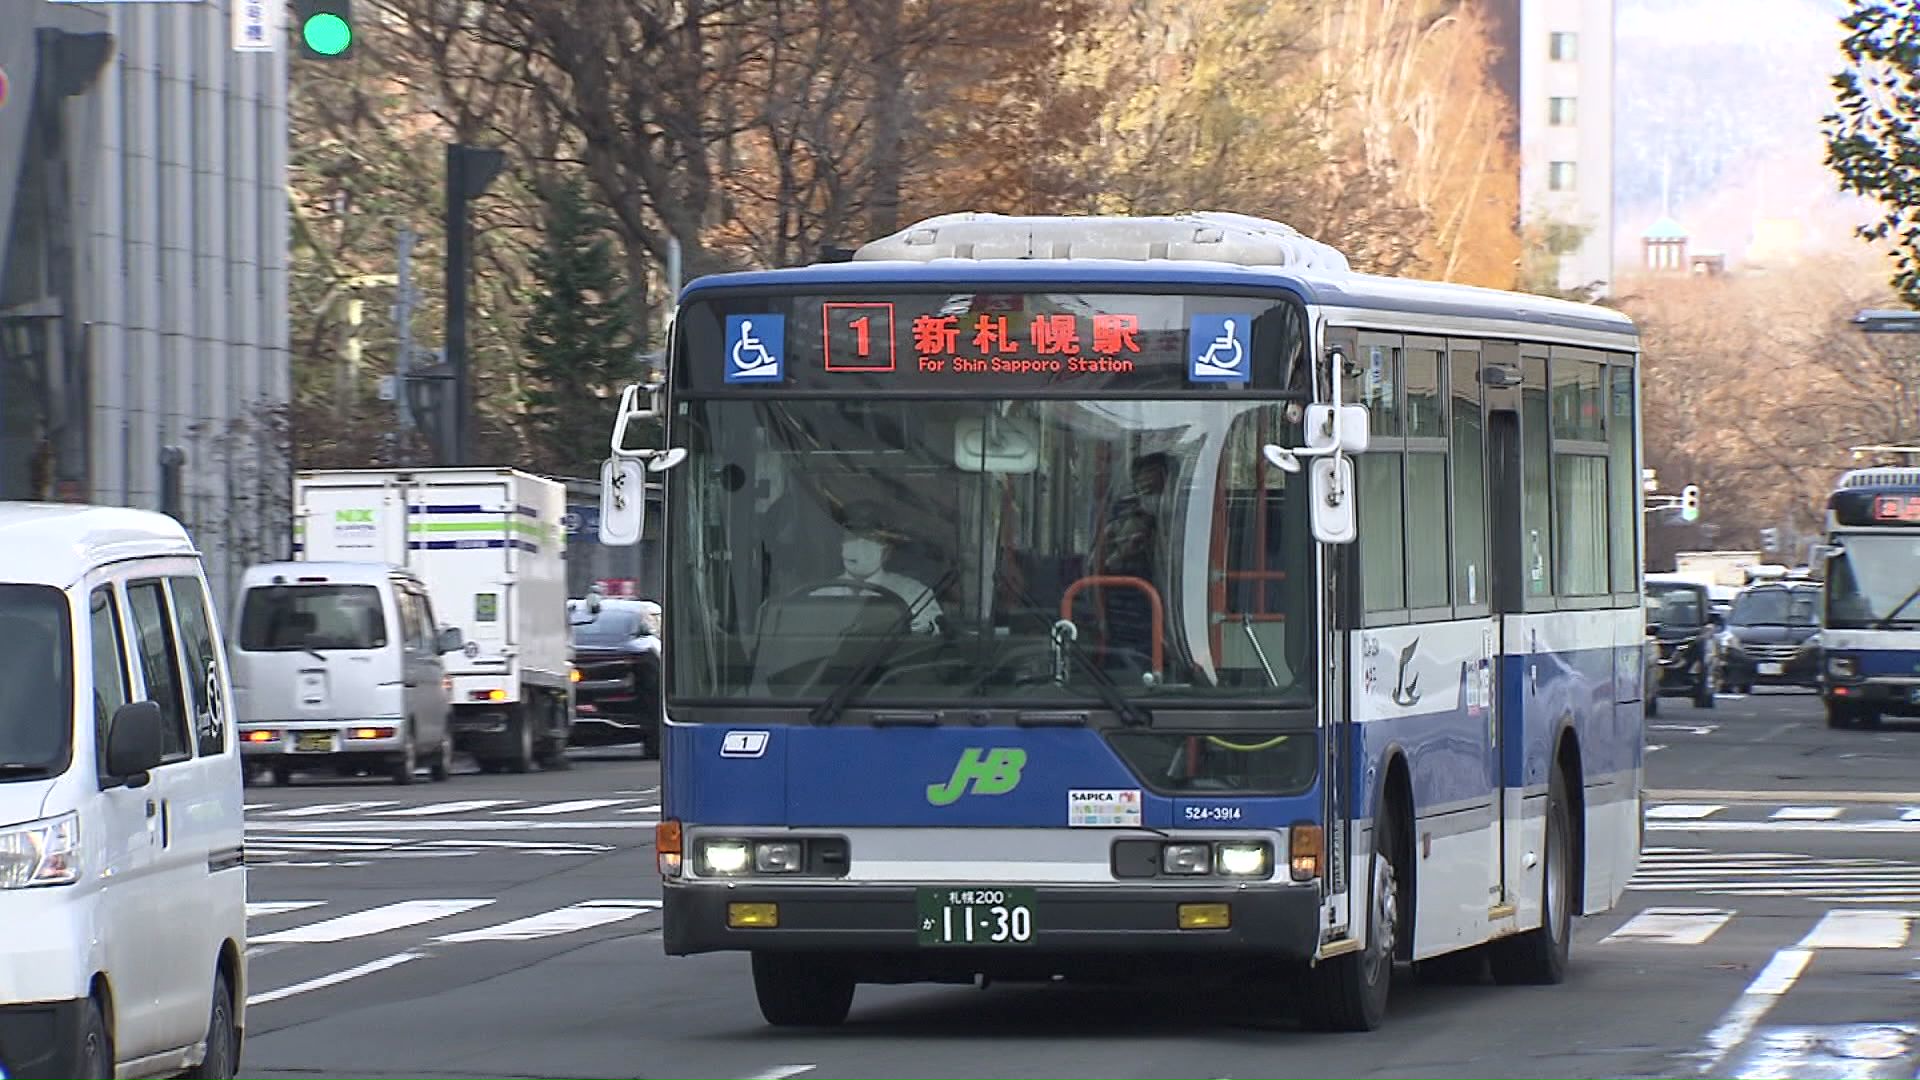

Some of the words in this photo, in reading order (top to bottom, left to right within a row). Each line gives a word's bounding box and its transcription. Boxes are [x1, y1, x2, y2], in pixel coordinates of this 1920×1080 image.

[849, 316, 869, 356] 1
[912, 315, 1140, 354] 新札幌駅
[919, 357, 944, 372] For
[952, 356, 987, 372] Shin
[991, 357, 1060, 374] Sapporo
[1067, 356, 1133, 372] Station
[1071, 792, 1114, 802] SAPICA
[1184, 807, 1241, 820] 524-3914
[943, 905, 1031, 942] 11-30
